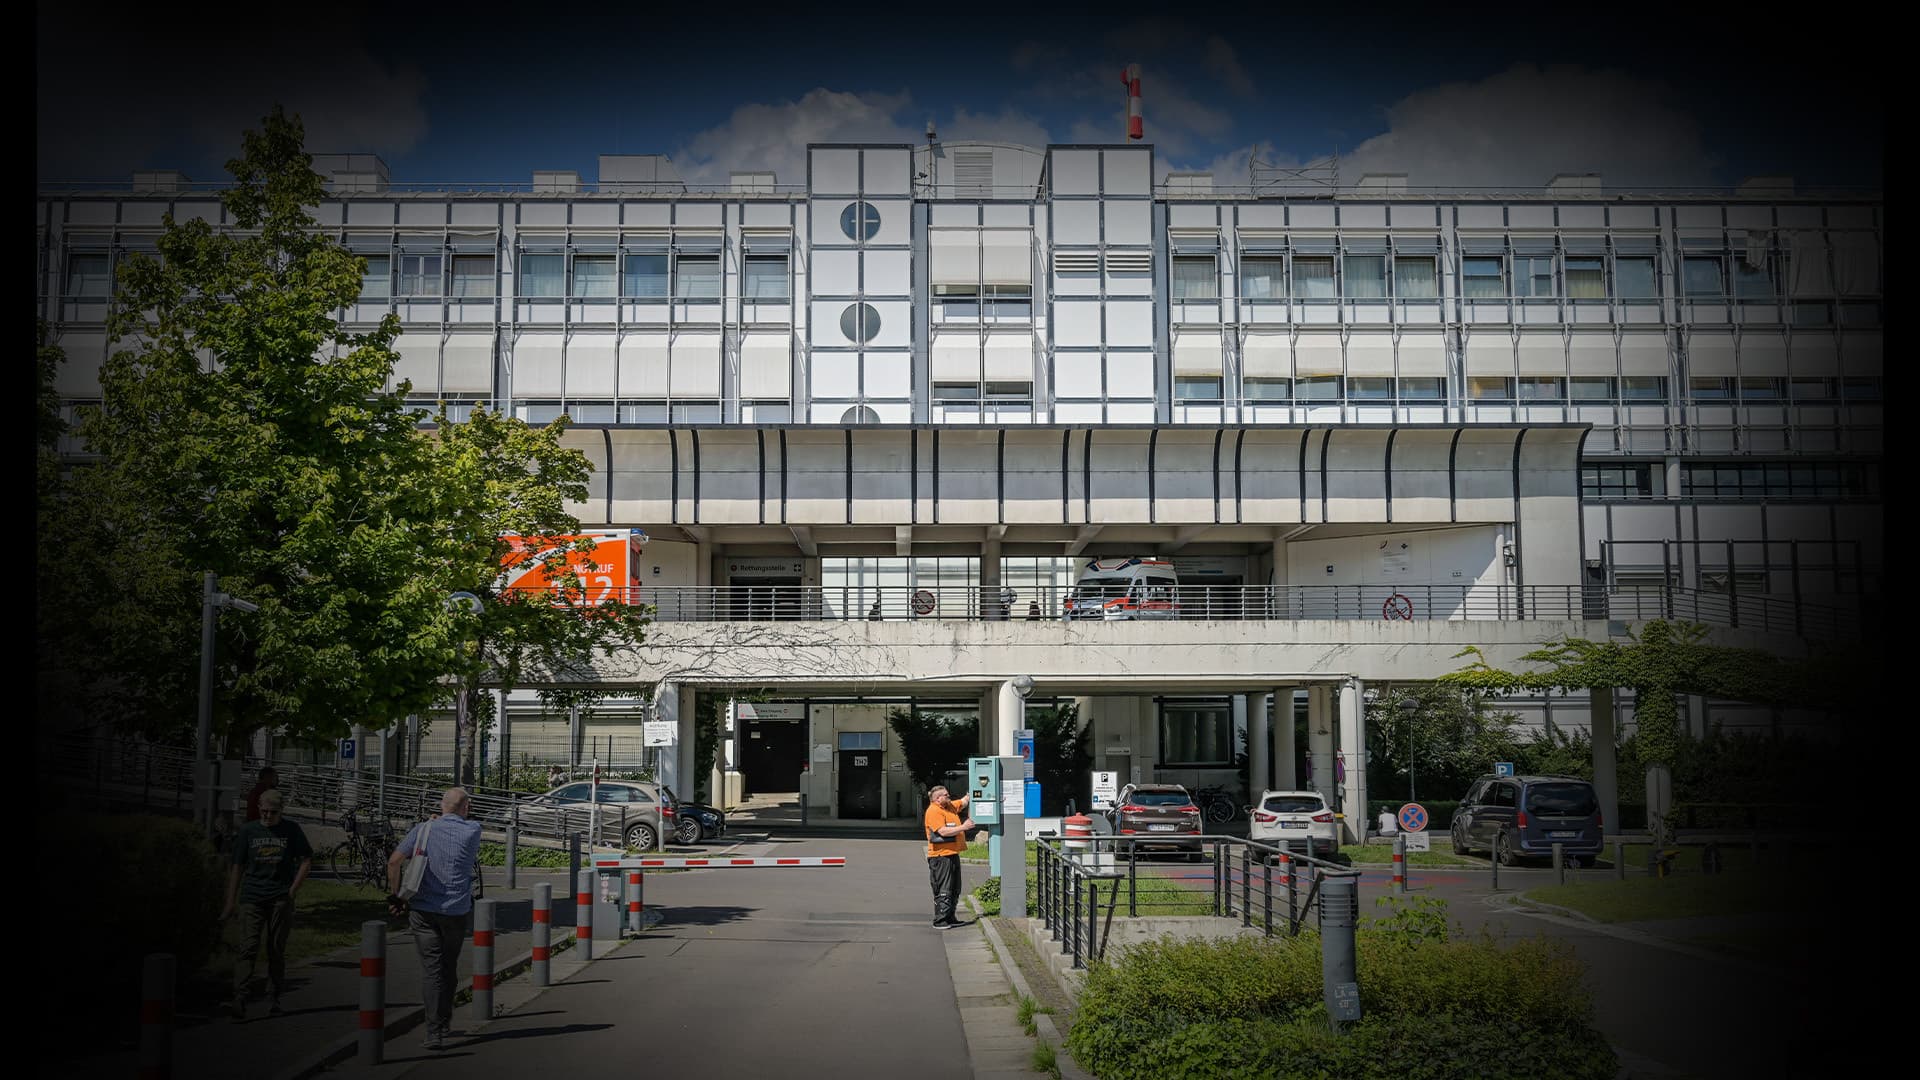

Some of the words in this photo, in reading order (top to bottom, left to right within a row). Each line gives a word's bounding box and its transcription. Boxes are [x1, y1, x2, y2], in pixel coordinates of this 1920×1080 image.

[740, 564, 786, 572] Rettungsstelle
[550, 576, 613, 606] 112
[344, 742, 353, 757] P
[1498, 765, 1507, 775] P
